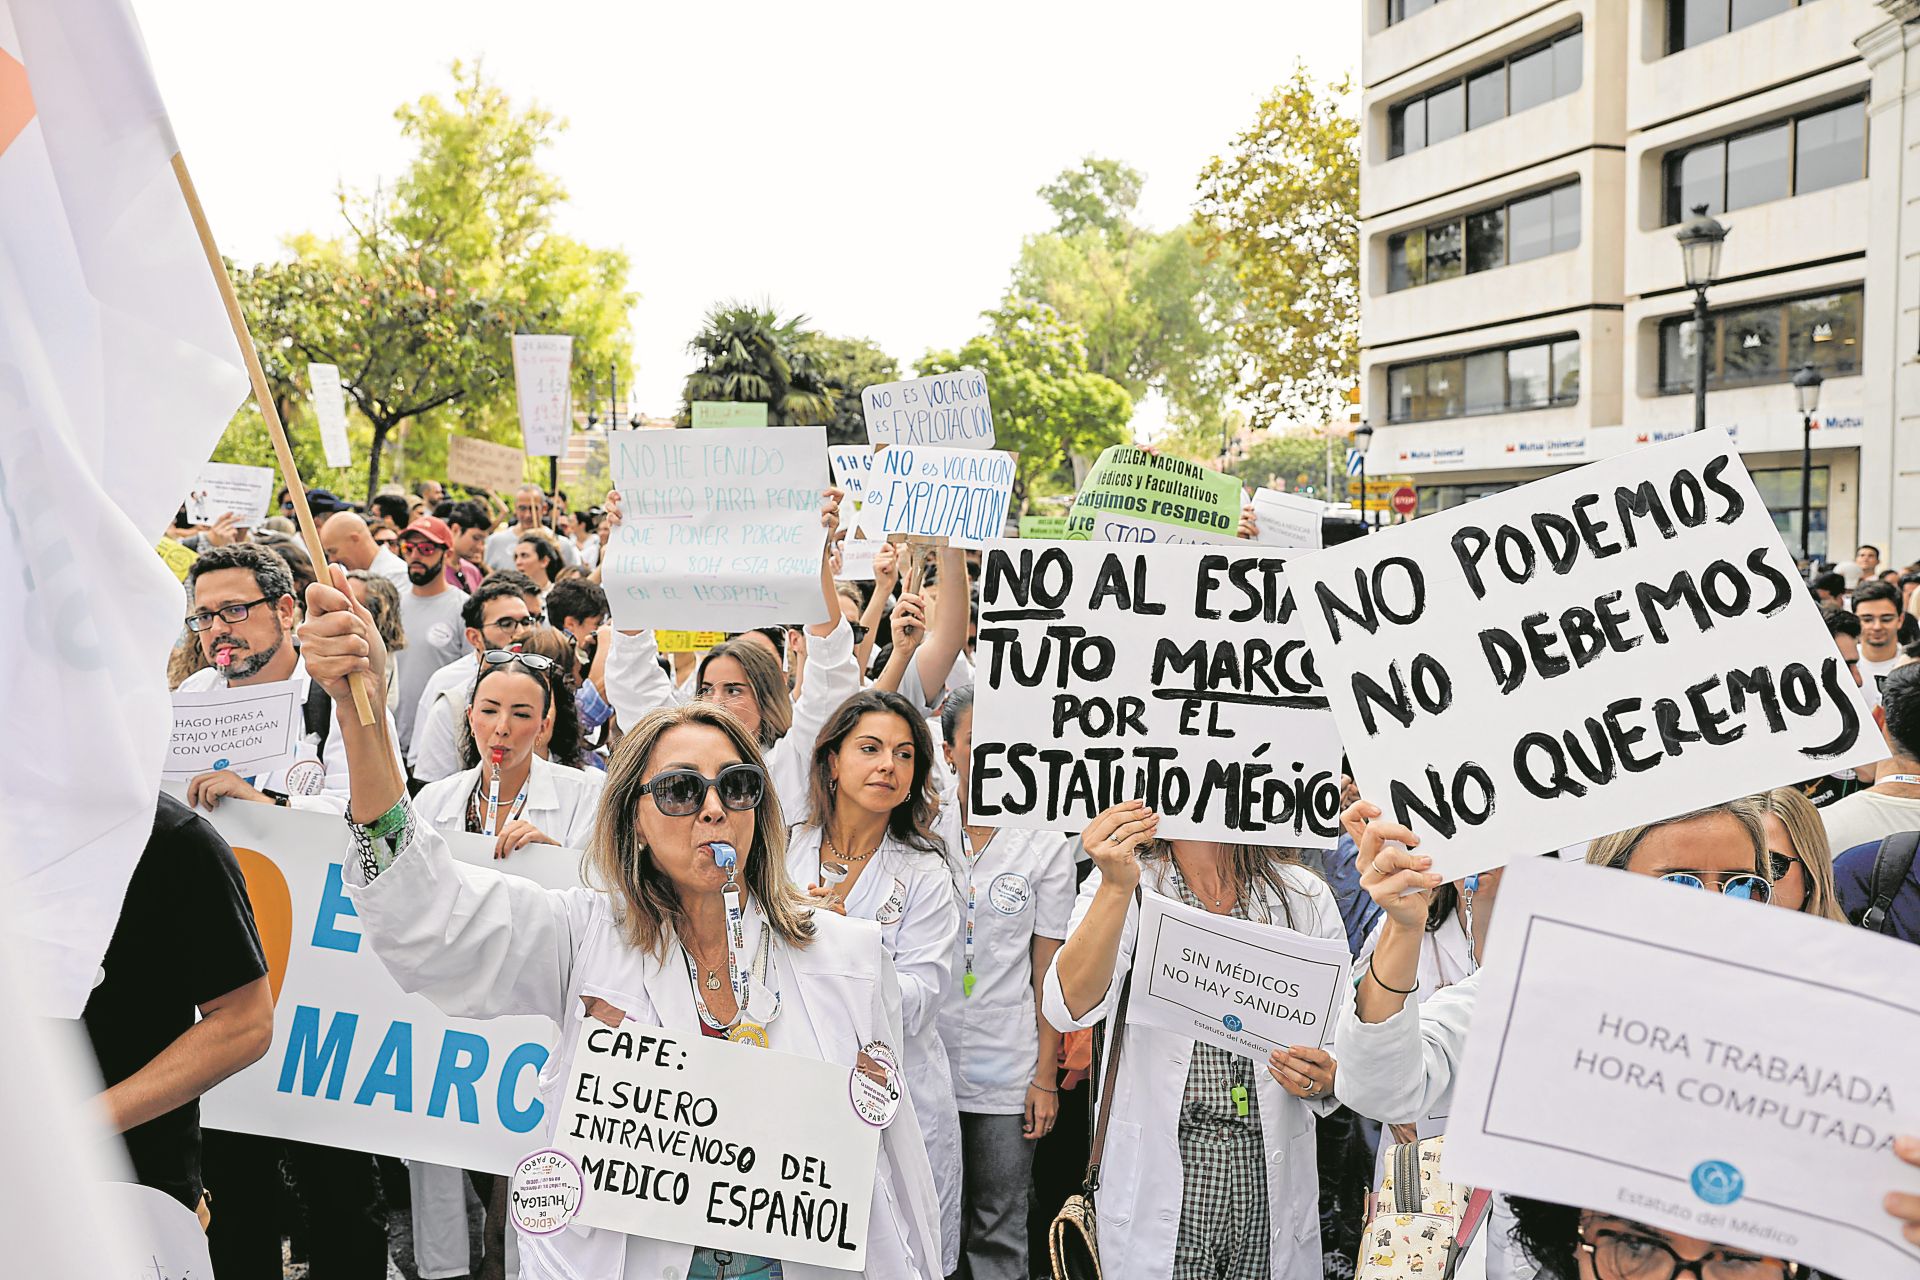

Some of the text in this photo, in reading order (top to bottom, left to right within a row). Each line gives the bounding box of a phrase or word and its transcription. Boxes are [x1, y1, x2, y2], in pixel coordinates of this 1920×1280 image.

[872, 375, 986, 410] NO ES VOCACIÓN
[876, 404, 992, 445] ES EXPLOTACIÓN
[620, 443, 785, 480] NO HE TENIDO
[884, 449, 1012, 486] NO es VOCACIÓN
[1112, 448, 1204, 481] HUELGA NACIONAL
[622, 487, 824, 516] TIEMPO PARA PENSAR
[867, 480, 1007, 541] es EXPLOTACIÓN
[1077, 490, 1147, 512] Exigimos
[1151, 500, 1230, 529] respeto
[1136, 476, 1143, 490] y
[1145, 474, 1218, 505] Facultativos
[668, 523, 729, 546] PONER
[742, 524, 804, 546] PORQUE
[1068, 515, 1077, 531] y
[731, 557, 769, 573] ESTA
[1314, 453, 1745, 645] NO PODEMOS
[627, 584, 790, 605] EN EL HOSPITAL
[983, 547, 1074, 608] NO
[1088, 552, 1166, 616] AL
[978, 624, 1117, 690] TUTO
[1350, 546, 1793, 737] NO DEBEMOS
[170, 720, 279, 743] STAJO Y ME PAGAN
[174, 710, 265, 728] HAGO HORAS A
[1051, 694, 1236, 739] POR EL
[172, 735, 263, 755] CON VOCACIÓN
[1388, 655, 1861, 852] NO QUEREMOS
[970, 741, 1342, 837] ESTATUTO MÉDICO
[1181, 947, 1300, 998] SIN MÉDICOS
[1162, 963, 1317, 1026] NO HAY SANIDAD
[586, 1028, 688, 1071] CAFE:
[1193, 1019, 1268, 1053] Estatuto del Médico
[276, 1004, 550, 1134] MARC
[1597, 1012, 1897, 1114] HORA TRABAJADA
[1573, 1048, 1899, 1155] HORA COMPUTADA
[569, 1112, 833, 1190] INTRAVENOSO DEL
[520, 1195, 564, 1209] HUELGA
[581, 1155, 858, 1252] MEDICO ESPAÑOL
[1616, 1186, 1799, 1247] Estatuto del Médico
